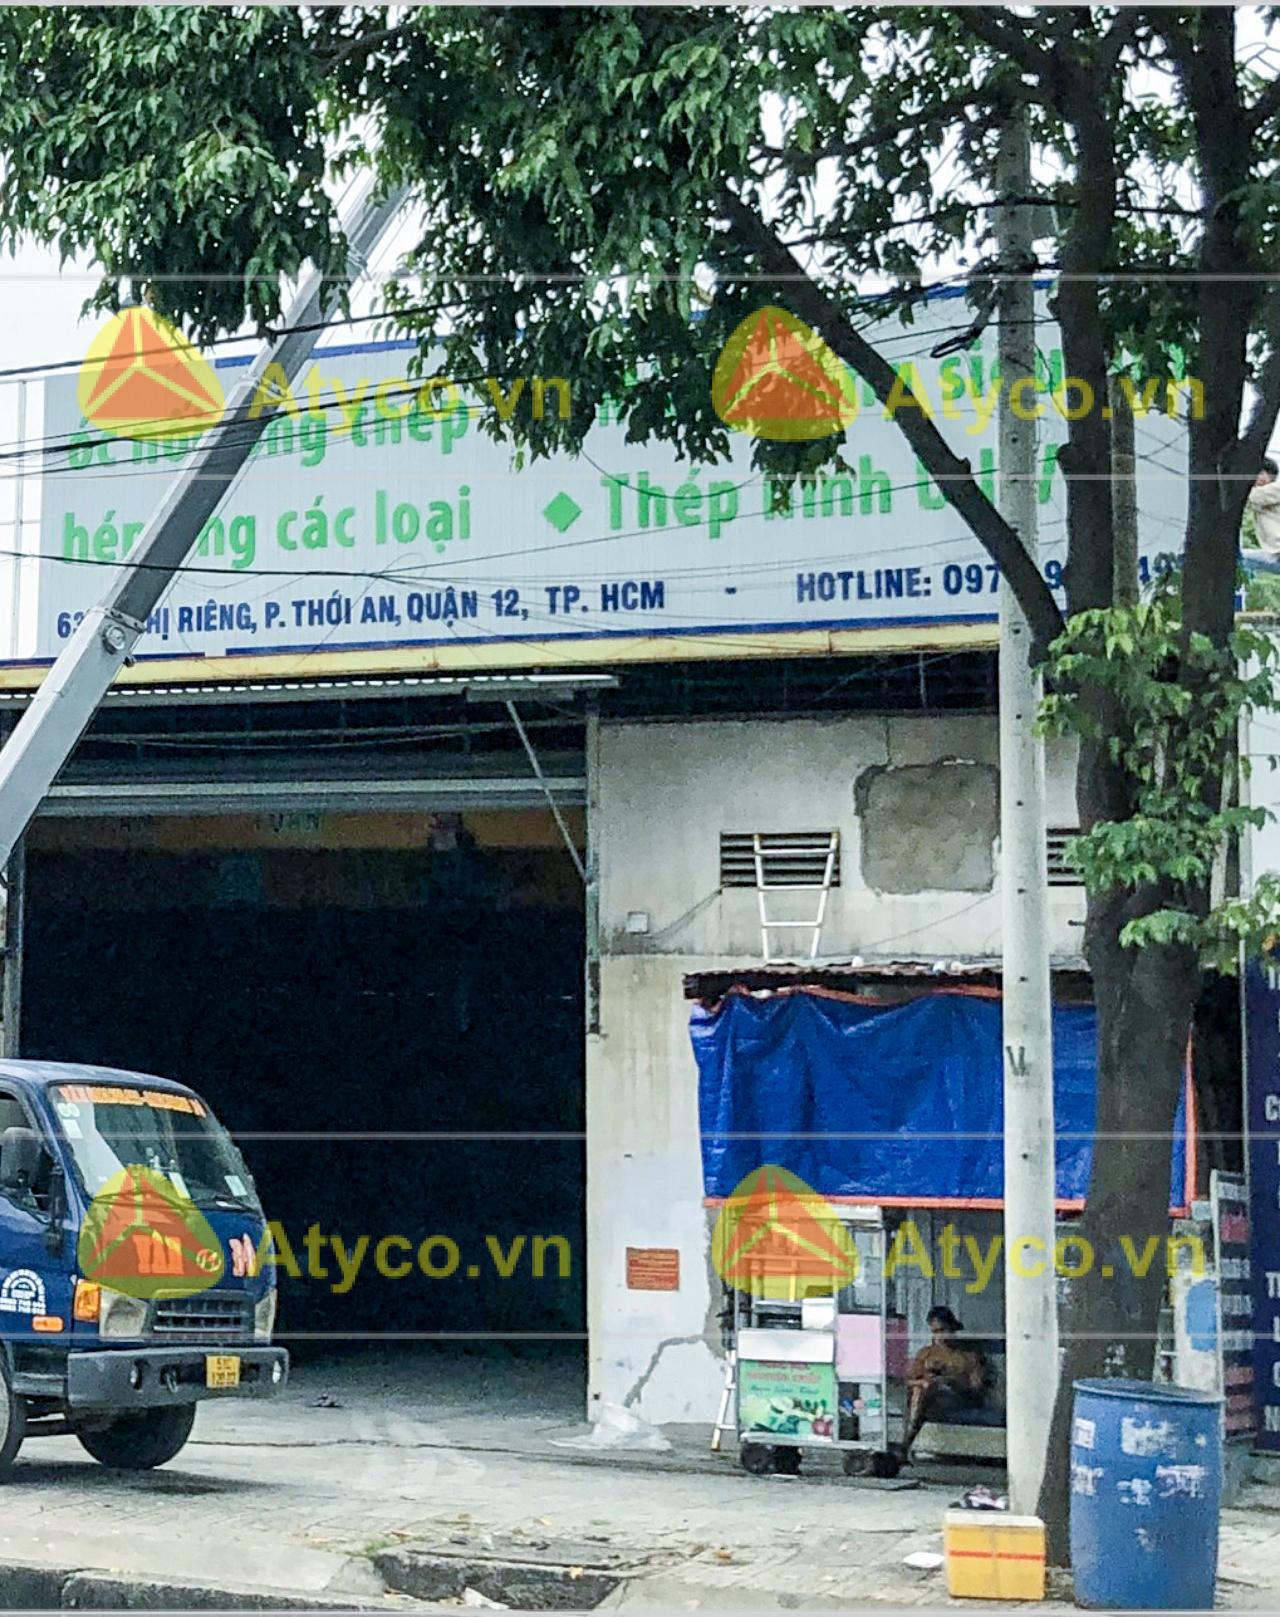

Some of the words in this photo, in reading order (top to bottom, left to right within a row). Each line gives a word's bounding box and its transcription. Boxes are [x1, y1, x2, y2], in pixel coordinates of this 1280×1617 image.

[276, 494, 357, 551] các
[375, 485, 471, 554] loại
[600, 467, 739, 539] Thép
[178, 599, 258, 634] RIÊNG,
[265, 609, 286, 629] P.
[292, 589, 352, 627] THỚI
[360, 594, 402, 627] AN,
[407, 585, 478, 628] QUẬN
[491, 588, 530, 621] 12,
[545, 585, 589, 615] TP.
[601, 581, 666, 613] HCM
[796, 565, 932, 603] HOTLINE:
